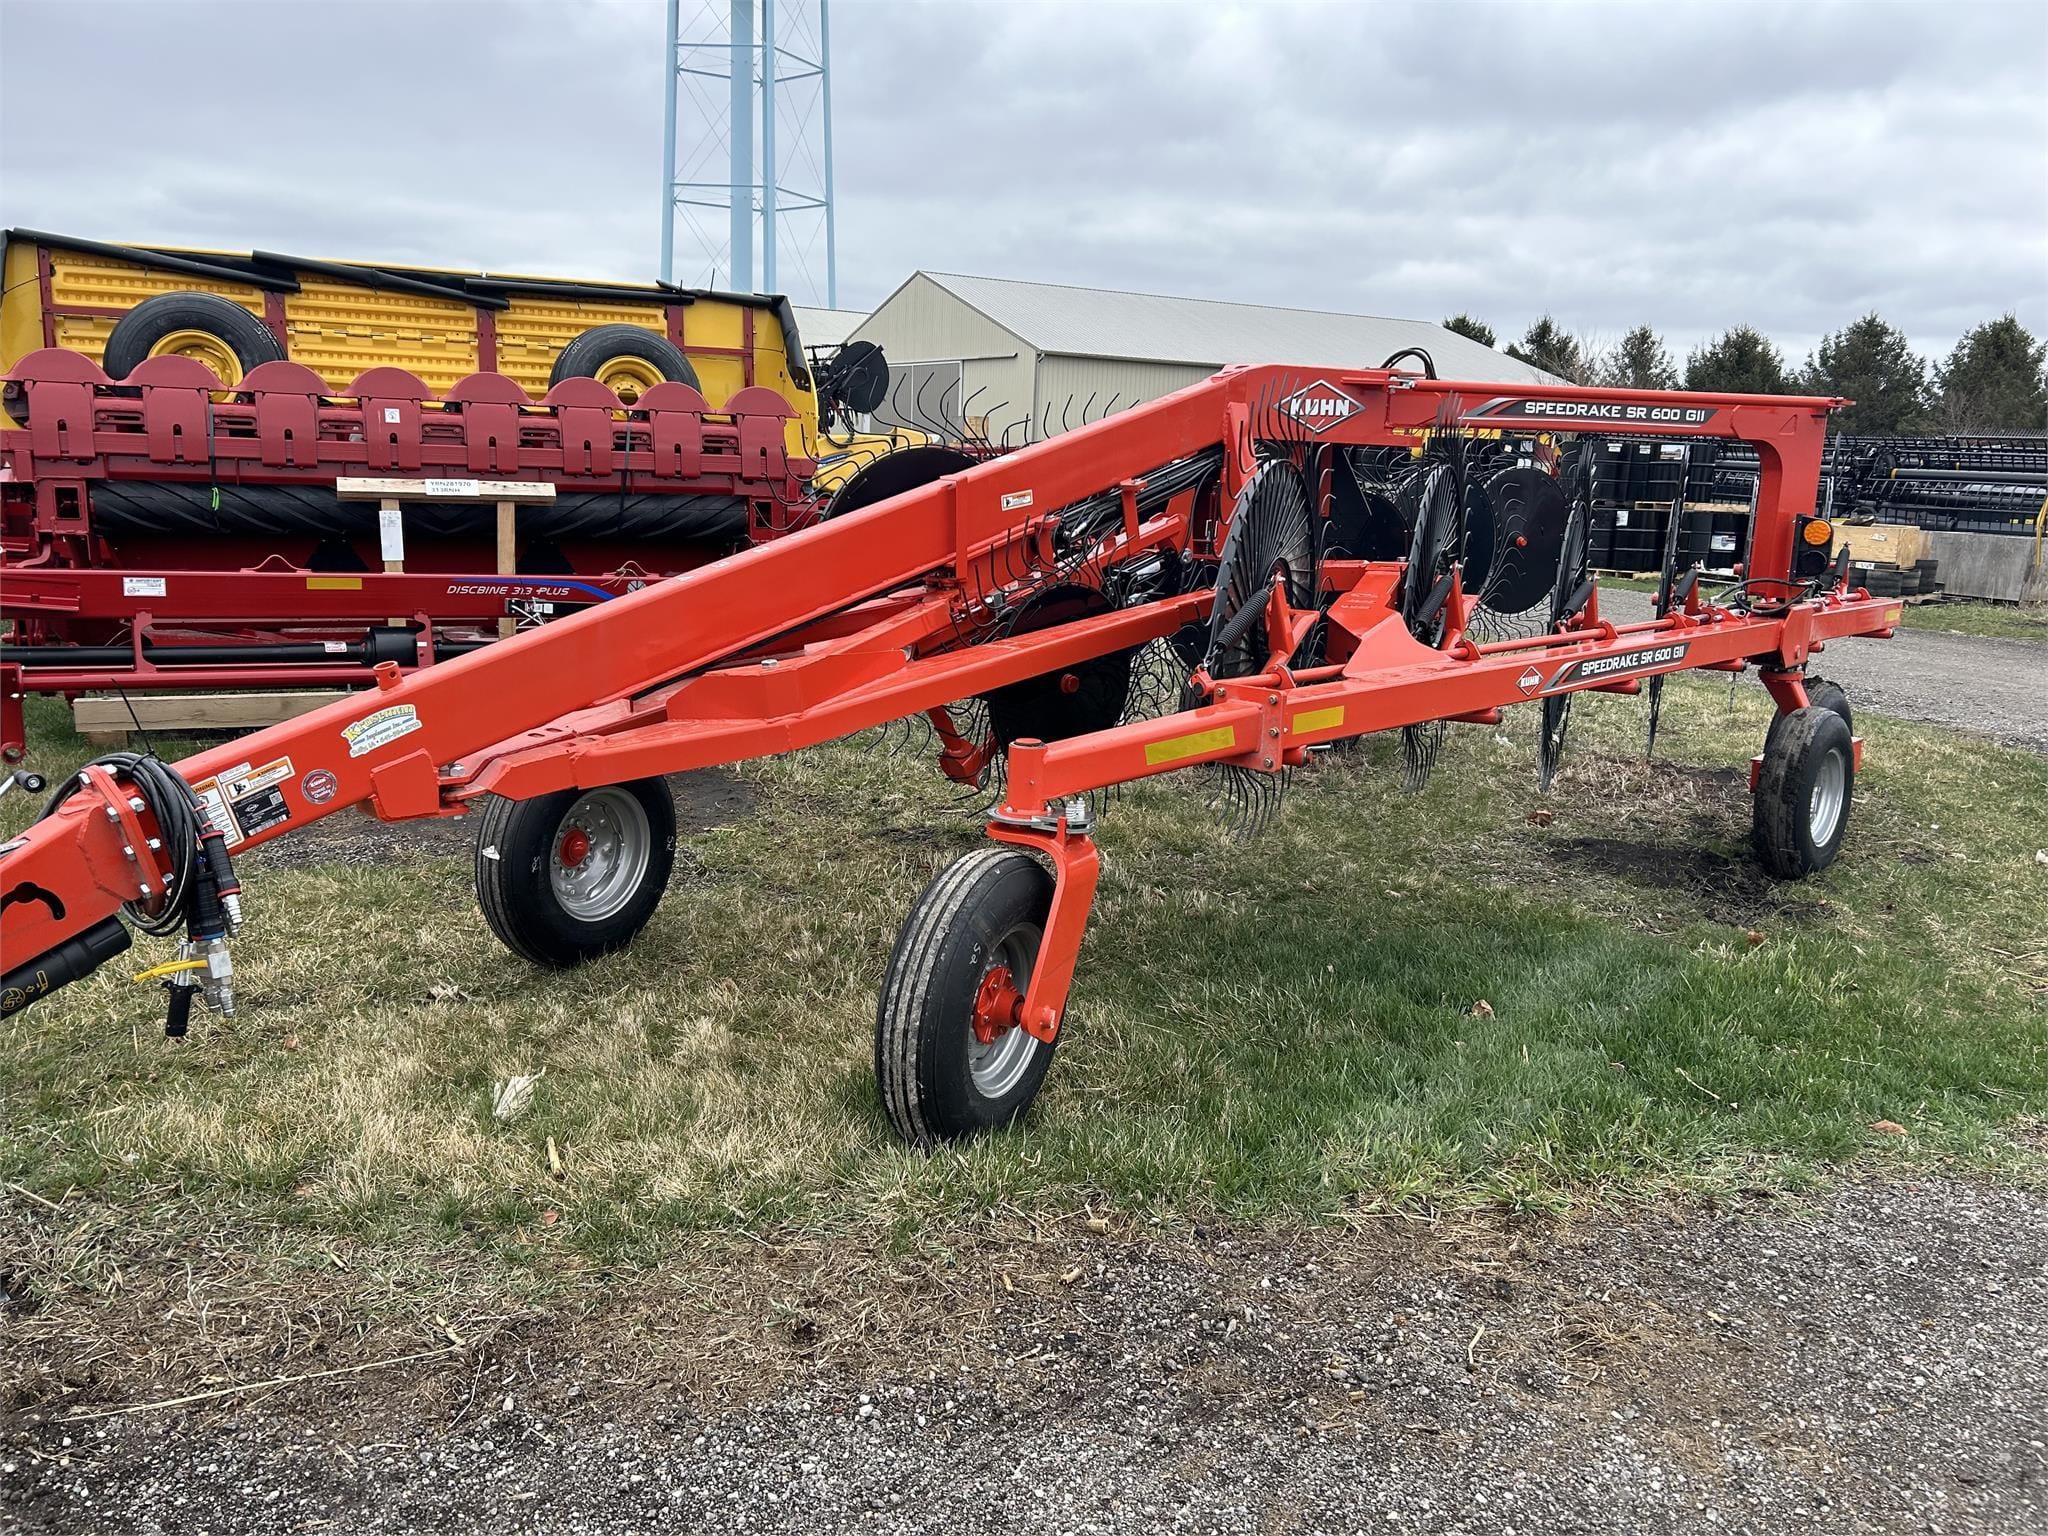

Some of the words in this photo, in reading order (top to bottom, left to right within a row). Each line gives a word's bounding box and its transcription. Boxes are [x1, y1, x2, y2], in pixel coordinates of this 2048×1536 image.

[1289, 398, 1350, 416] KUHN
[1524, 401, 1622, 419] SPEEDRAKE
[1625, 406, 1648, 420] SR
[1651, 407, 1681, 422] 600
[1685, 409, 1705, 423] GII
[446, 585, 509, 595] DISCBINE
[536, 587, 570, 597] PLUS
[1581, 652, 1639, 677] SPEEDRAKE
[1640, 650, 1653, 664] SR
[1654, 647, 1672, 662] 600
[1519, 675, 1540, 688] KUHN
